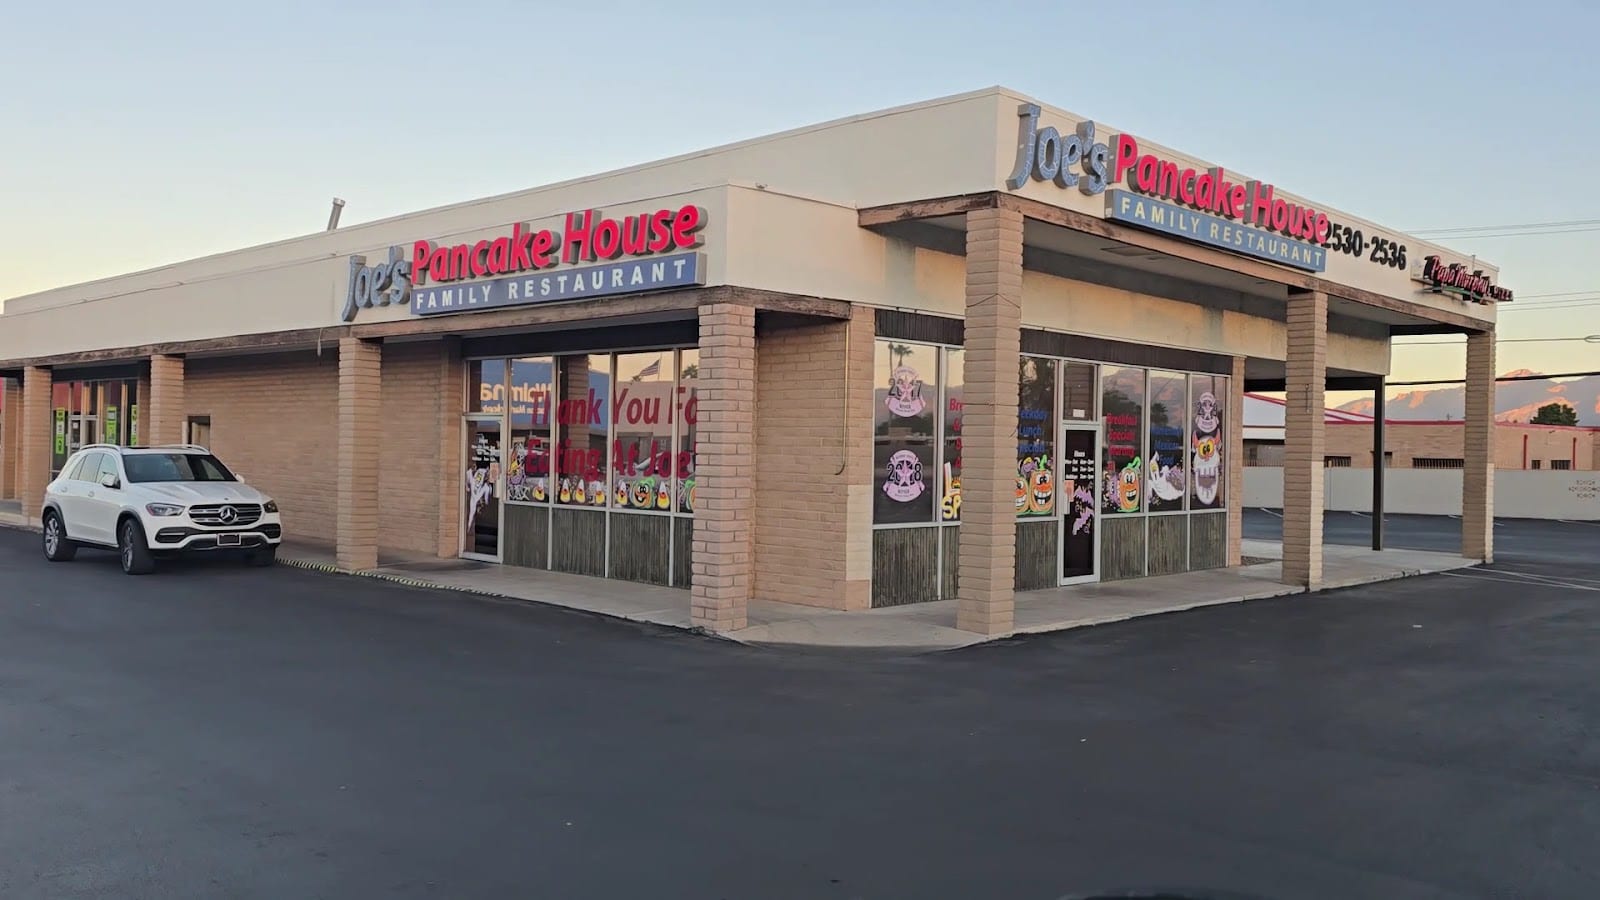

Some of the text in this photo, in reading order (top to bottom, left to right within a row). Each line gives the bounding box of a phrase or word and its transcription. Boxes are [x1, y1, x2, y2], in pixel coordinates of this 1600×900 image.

[1006, 103, 1328, 243] Joe's Pancake House
[1121, 197, 1322, 266] FAMILY RESTAURANT
[1322, 221, 1406, 270] 2530-2536
[341, 205, 700, 322] Joe's Pancake House
[417, 259, 686, 309] FAMILY RESTAURANT
[531, 387, 697, 425] Thank You Fo
[525, 438, 600, 482] Eating
[612, 439, 639, 476] At
